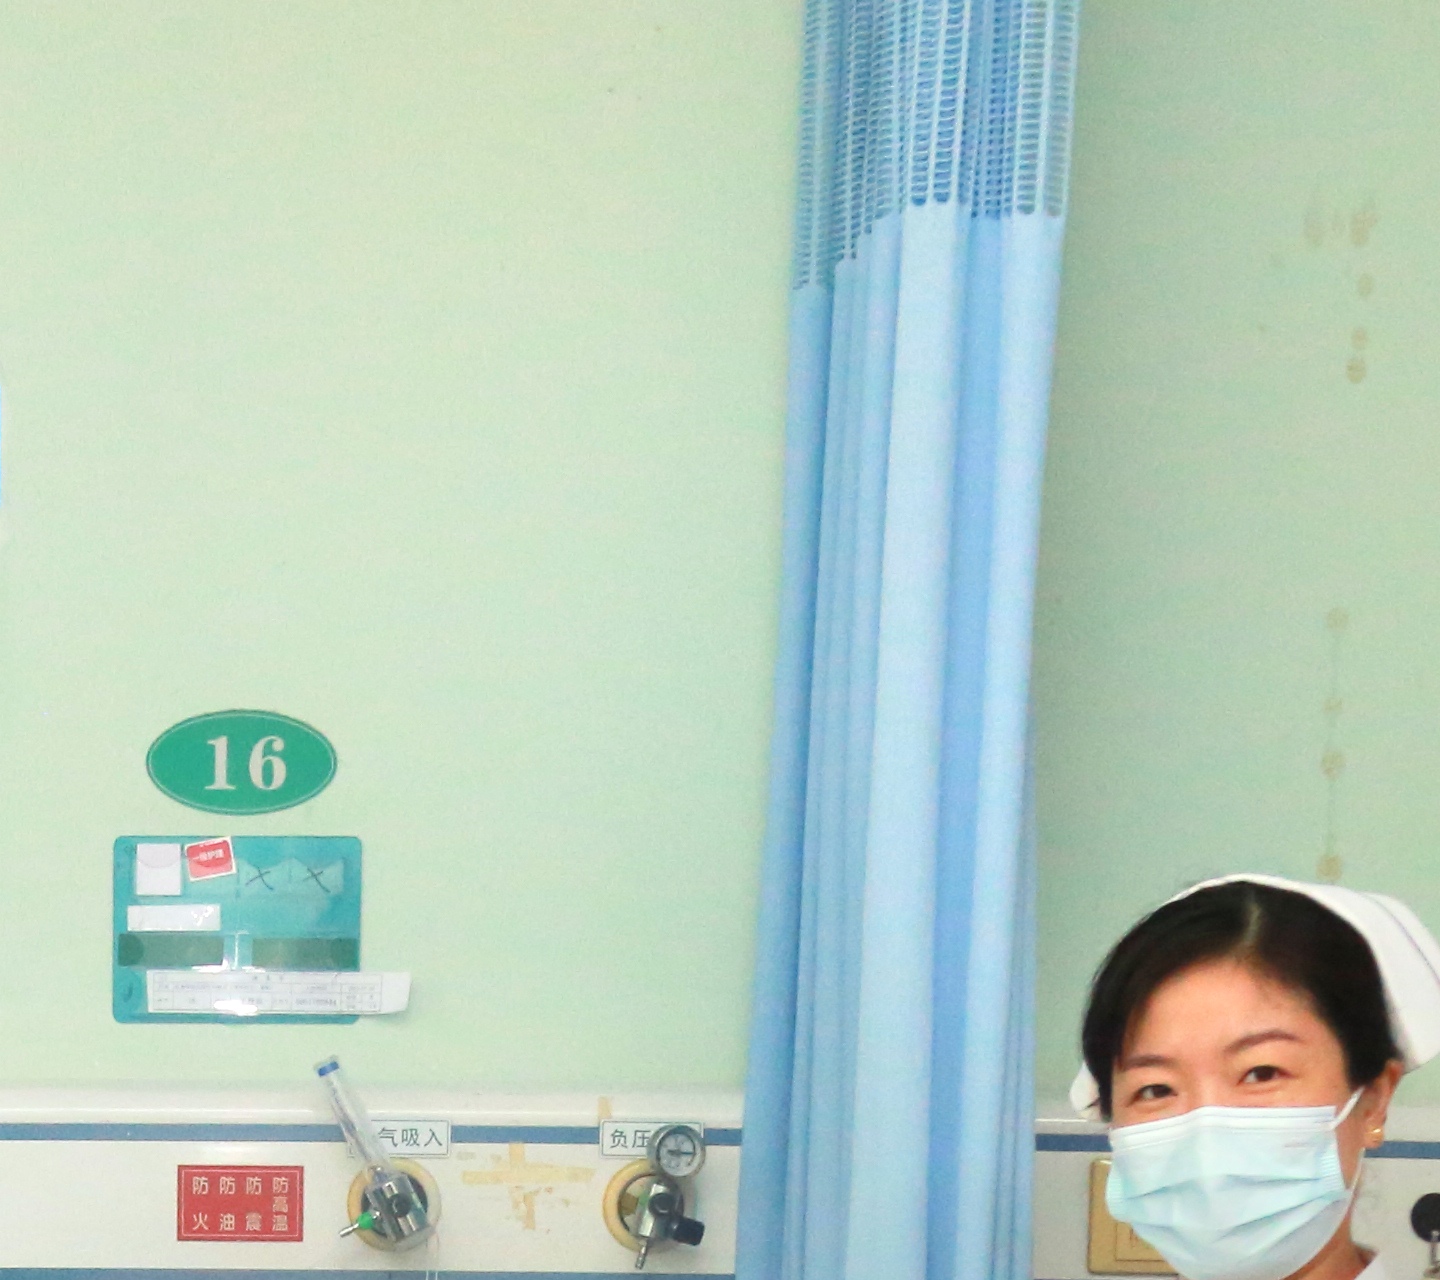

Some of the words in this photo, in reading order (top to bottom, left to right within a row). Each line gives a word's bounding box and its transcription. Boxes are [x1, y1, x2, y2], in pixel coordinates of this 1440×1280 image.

[204, 735, 287, 791] 16
[377, 1127, 443, 1147] 气吸入
[192, 1176, 209, 1231] 防火
[219, 1176, 236, 1231] 防油
